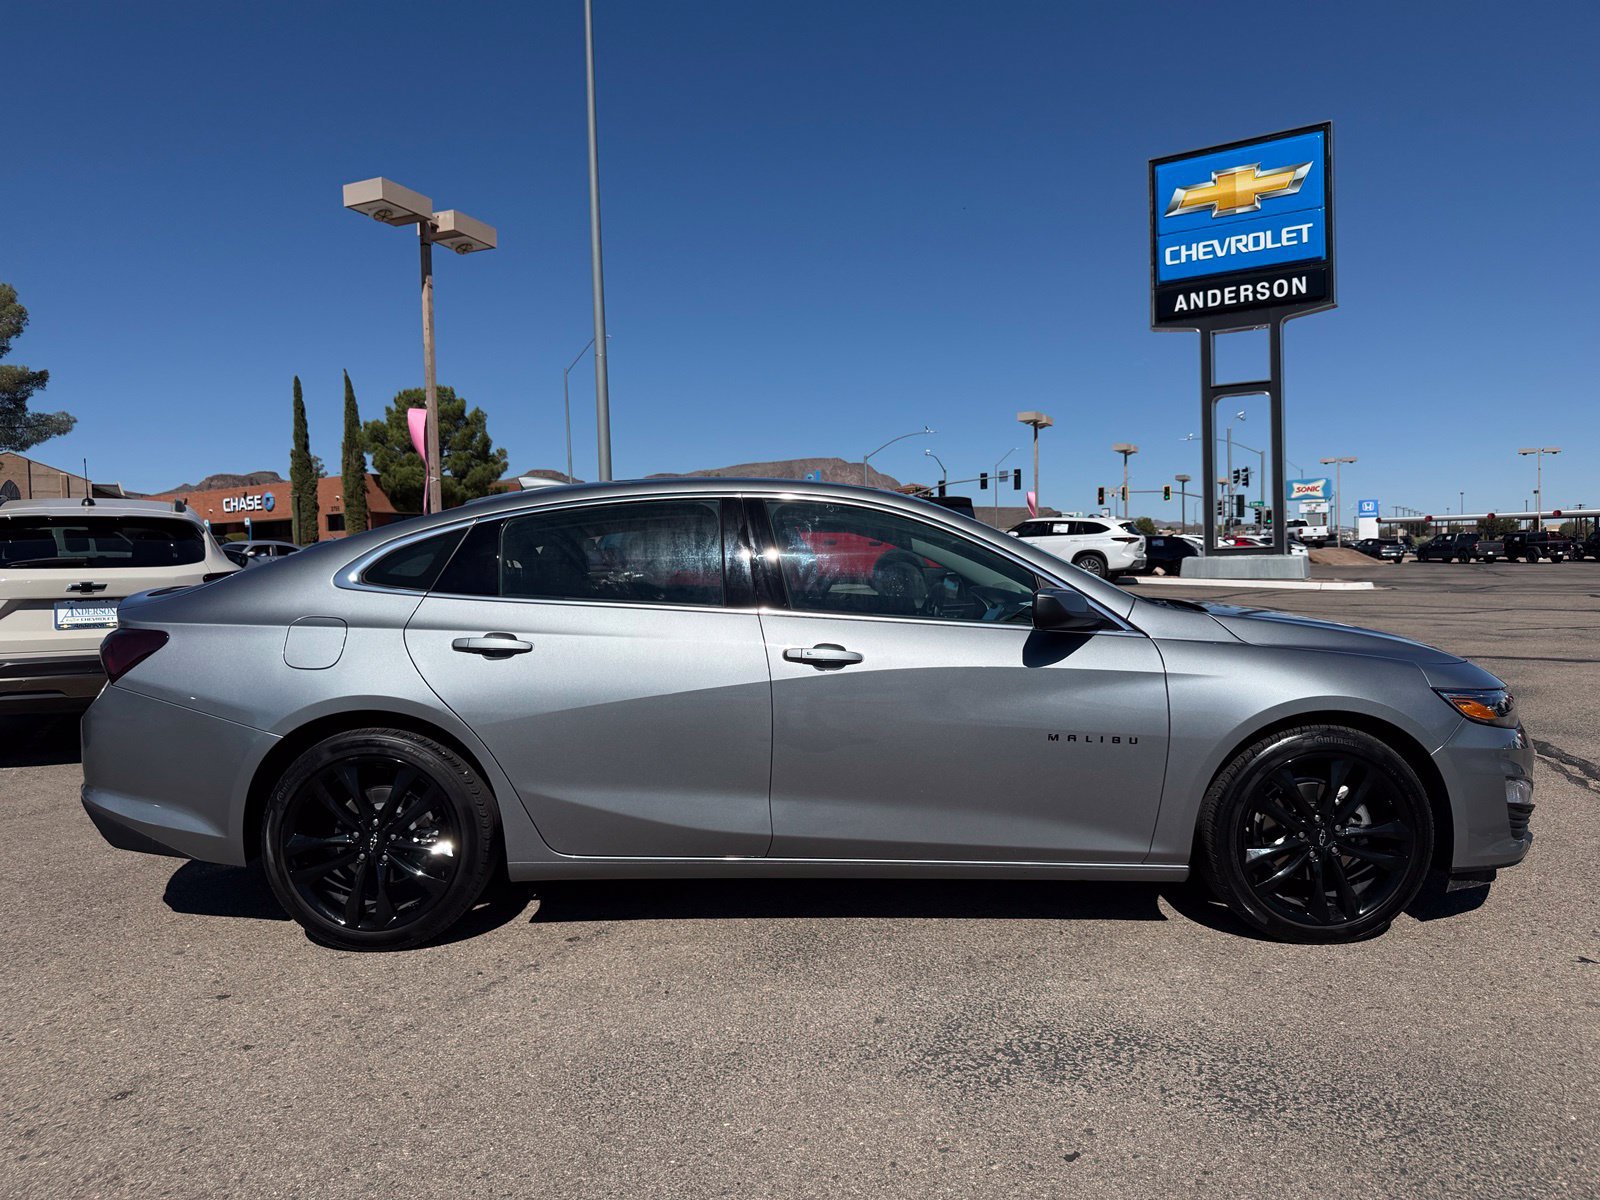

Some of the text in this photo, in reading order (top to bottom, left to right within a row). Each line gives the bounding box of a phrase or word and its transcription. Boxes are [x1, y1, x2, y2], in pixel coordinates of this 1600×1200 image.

[1165, 223, 1313, 266] CHEVROLET
[1174, 276, 1308, 312] ANDERSON
[1295, 485, 1320, 494] SONIC
[223, 495, 262, 512] CHASE
[60, 607, 117, 622] ANDERSON
[1047, 733, 1138, 745] MALIBU
